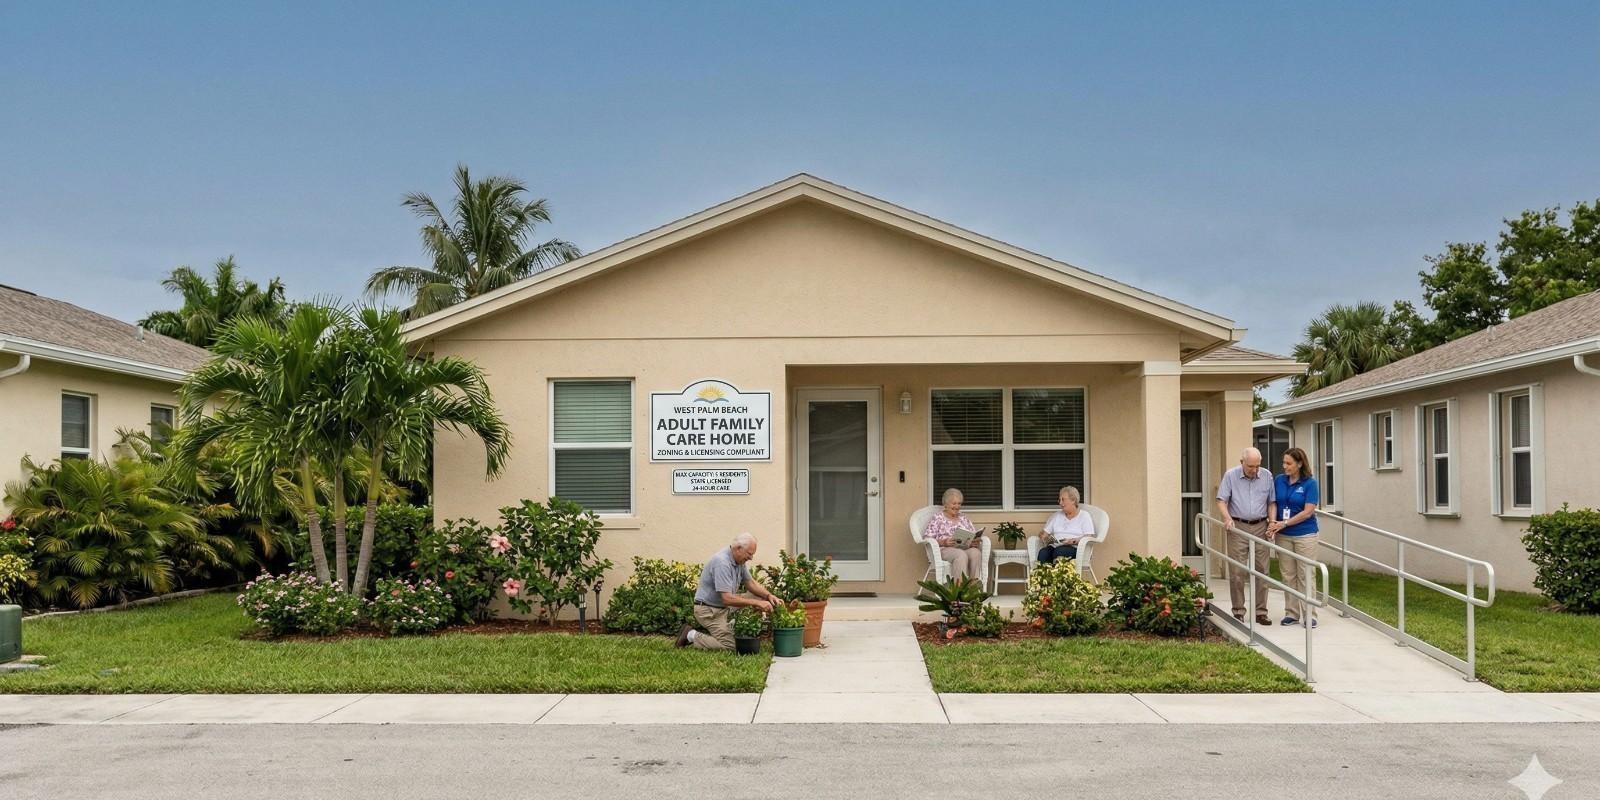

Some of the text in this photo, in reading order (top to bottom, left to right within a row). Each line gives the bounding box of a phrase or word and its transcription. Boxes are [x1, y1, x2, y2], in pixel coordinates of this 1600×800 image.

[657, 418, 764, 430] ADULT FAMILY
[666, 433, 756, 445] CARE HOME
